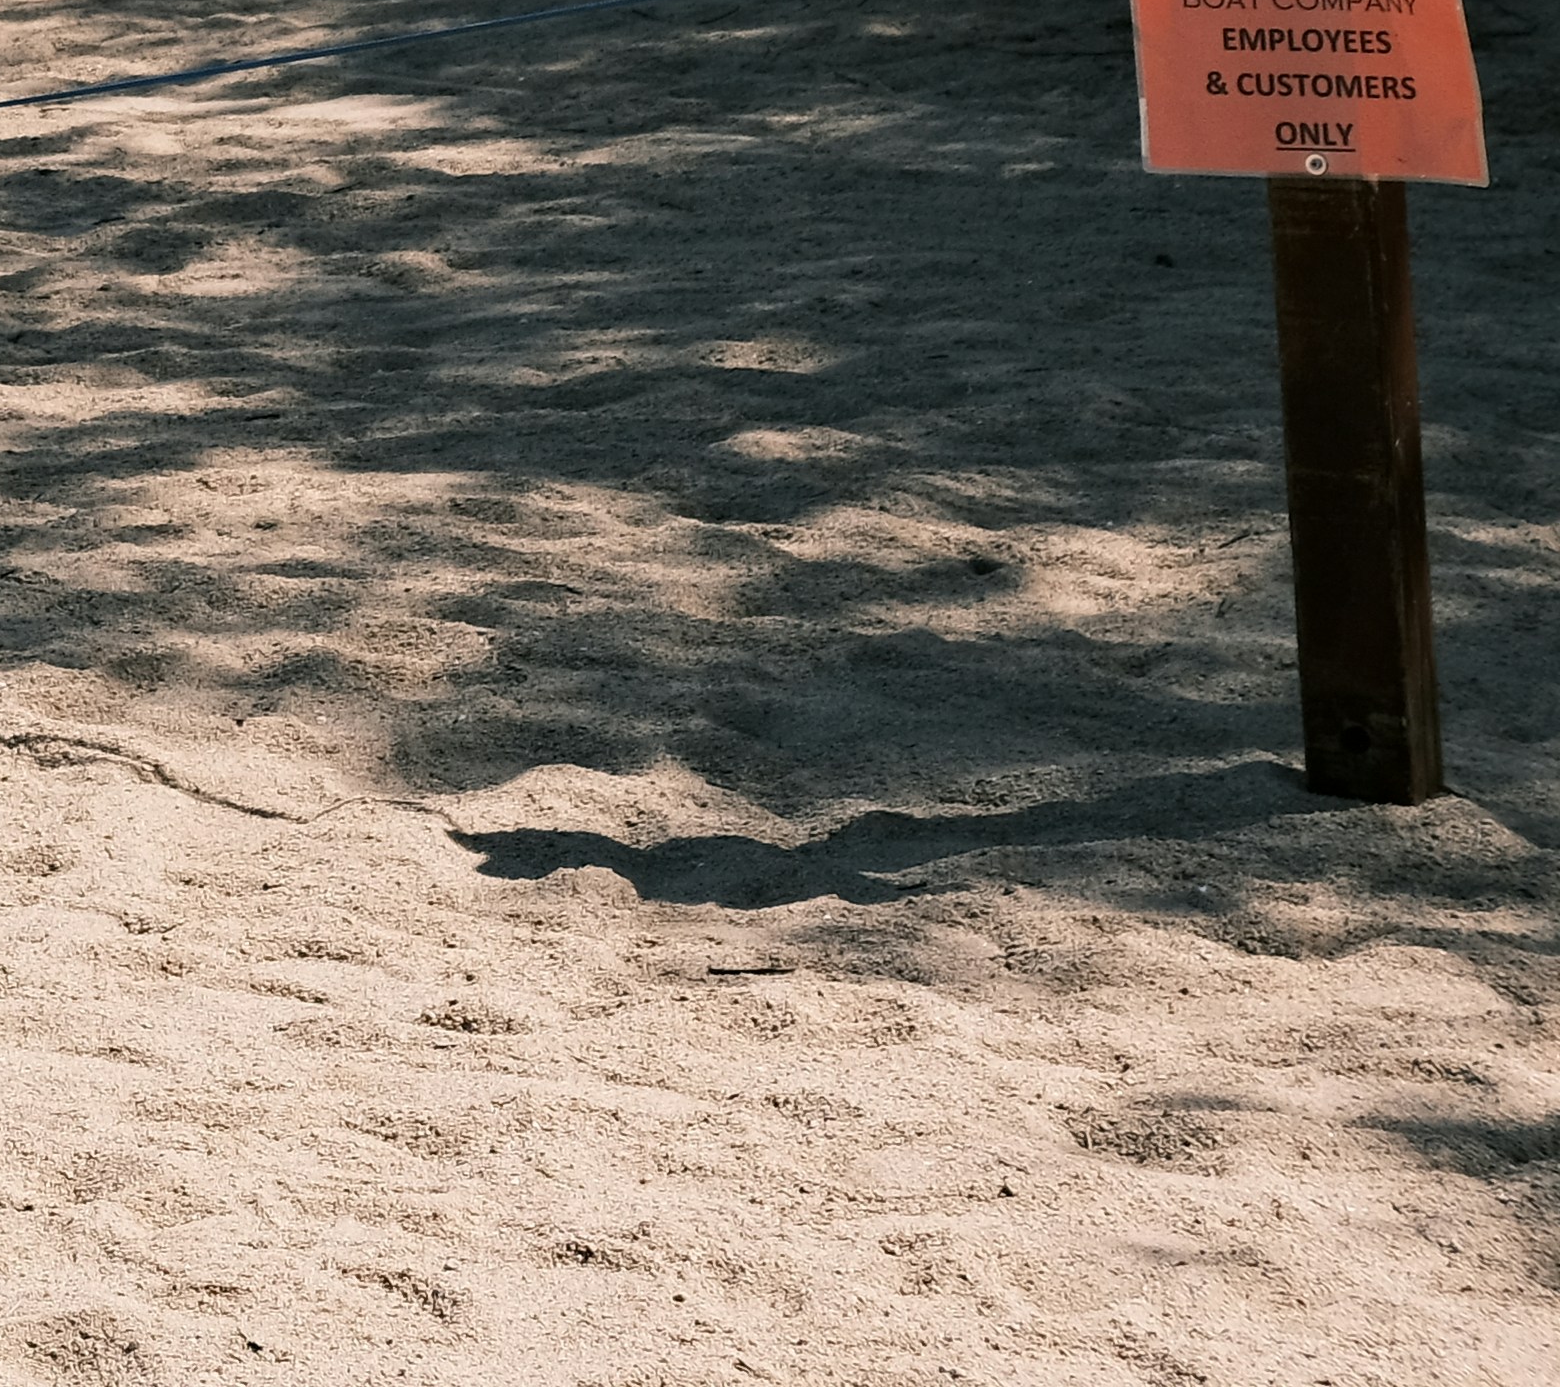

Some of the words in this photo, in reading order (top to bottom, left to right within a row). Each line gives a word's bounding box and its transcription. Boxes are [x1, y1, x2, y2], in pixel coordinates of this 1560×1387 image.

[1223, 28, 1392, 54] EMPLOYEES
[1206, 71, 1228, 96] &
[1237, 73, 1417, 100] CUSTOMERS
[1275, 121, 1354, 147] ONLY
